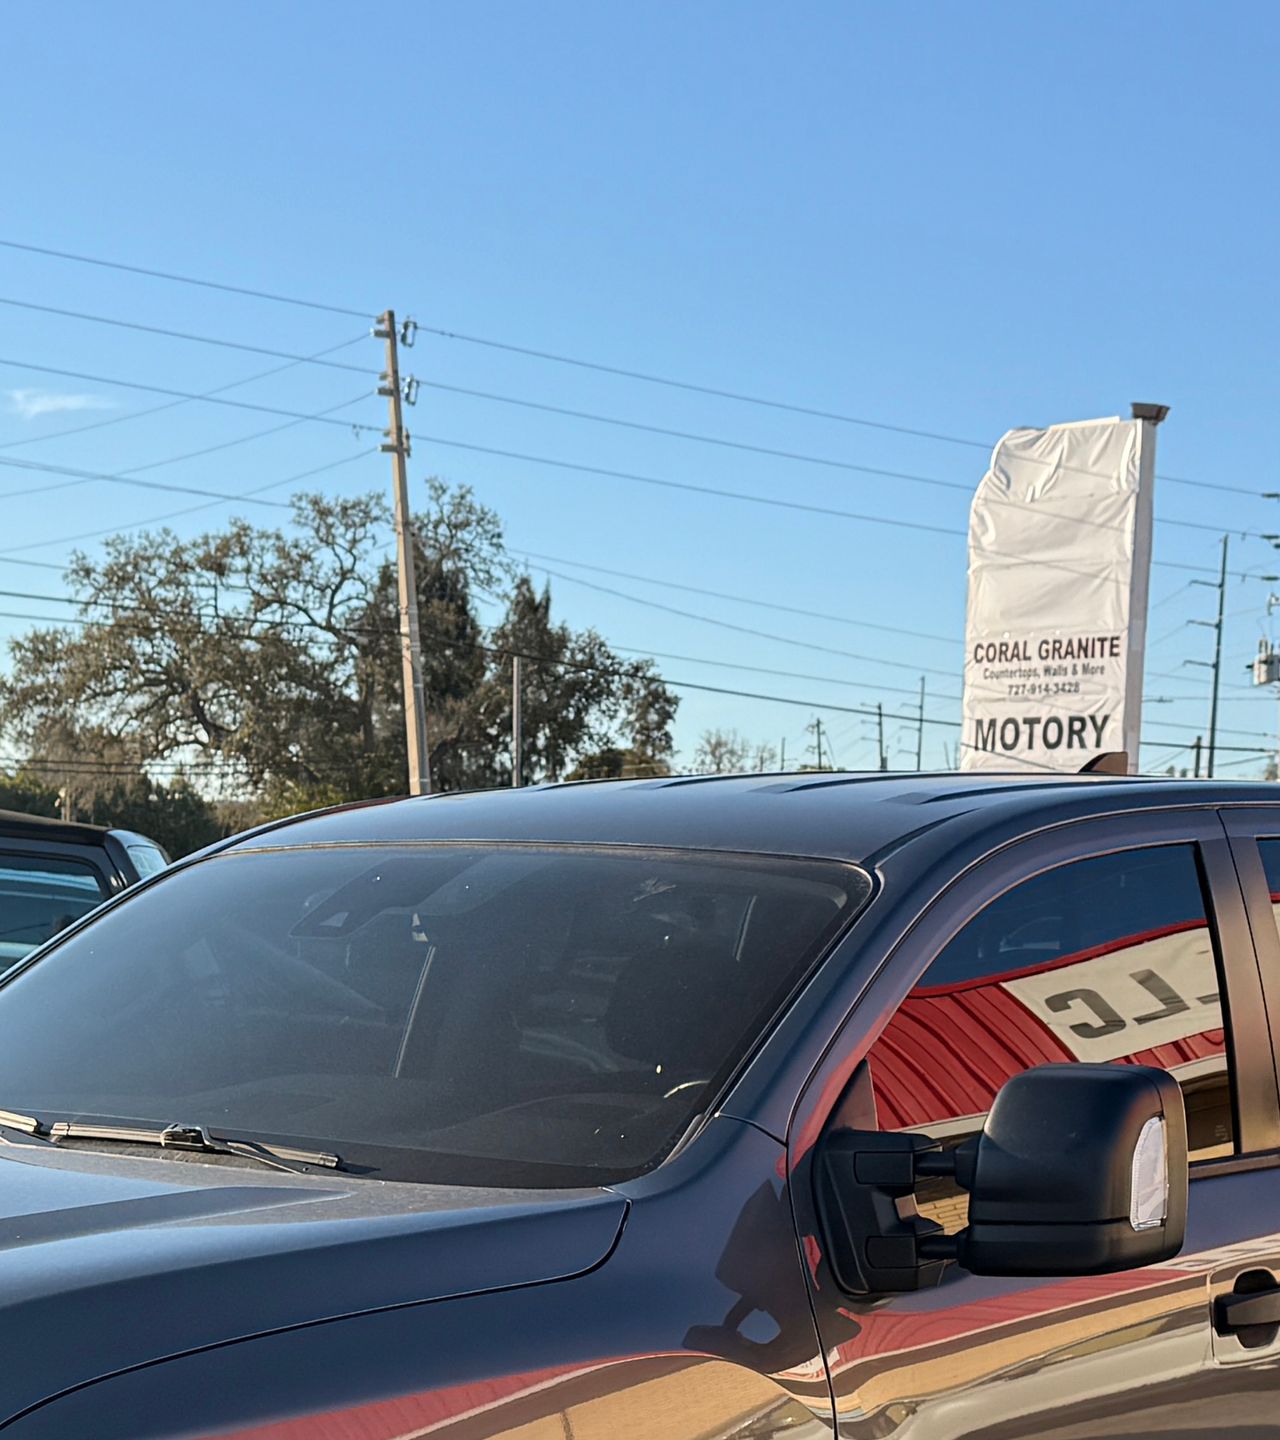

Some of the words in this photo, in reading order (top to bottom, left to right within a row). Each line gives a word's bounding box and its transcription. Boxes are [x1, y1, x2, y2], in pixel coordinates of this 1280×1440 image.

[974, 640, 1032, 663] CORAL
[1038, 636, 1121, 660] GRANITE
[983, 667, 1041, 681] Countertops,
[1044, 665, 1068, 677] Walls
[1072, 664, 1078, 675] &
[1082, 663, 1105, 676] More
[1008, 682, 1080, 696] 727-914-3428
[975, 714, 1111, 751] MOTORY
